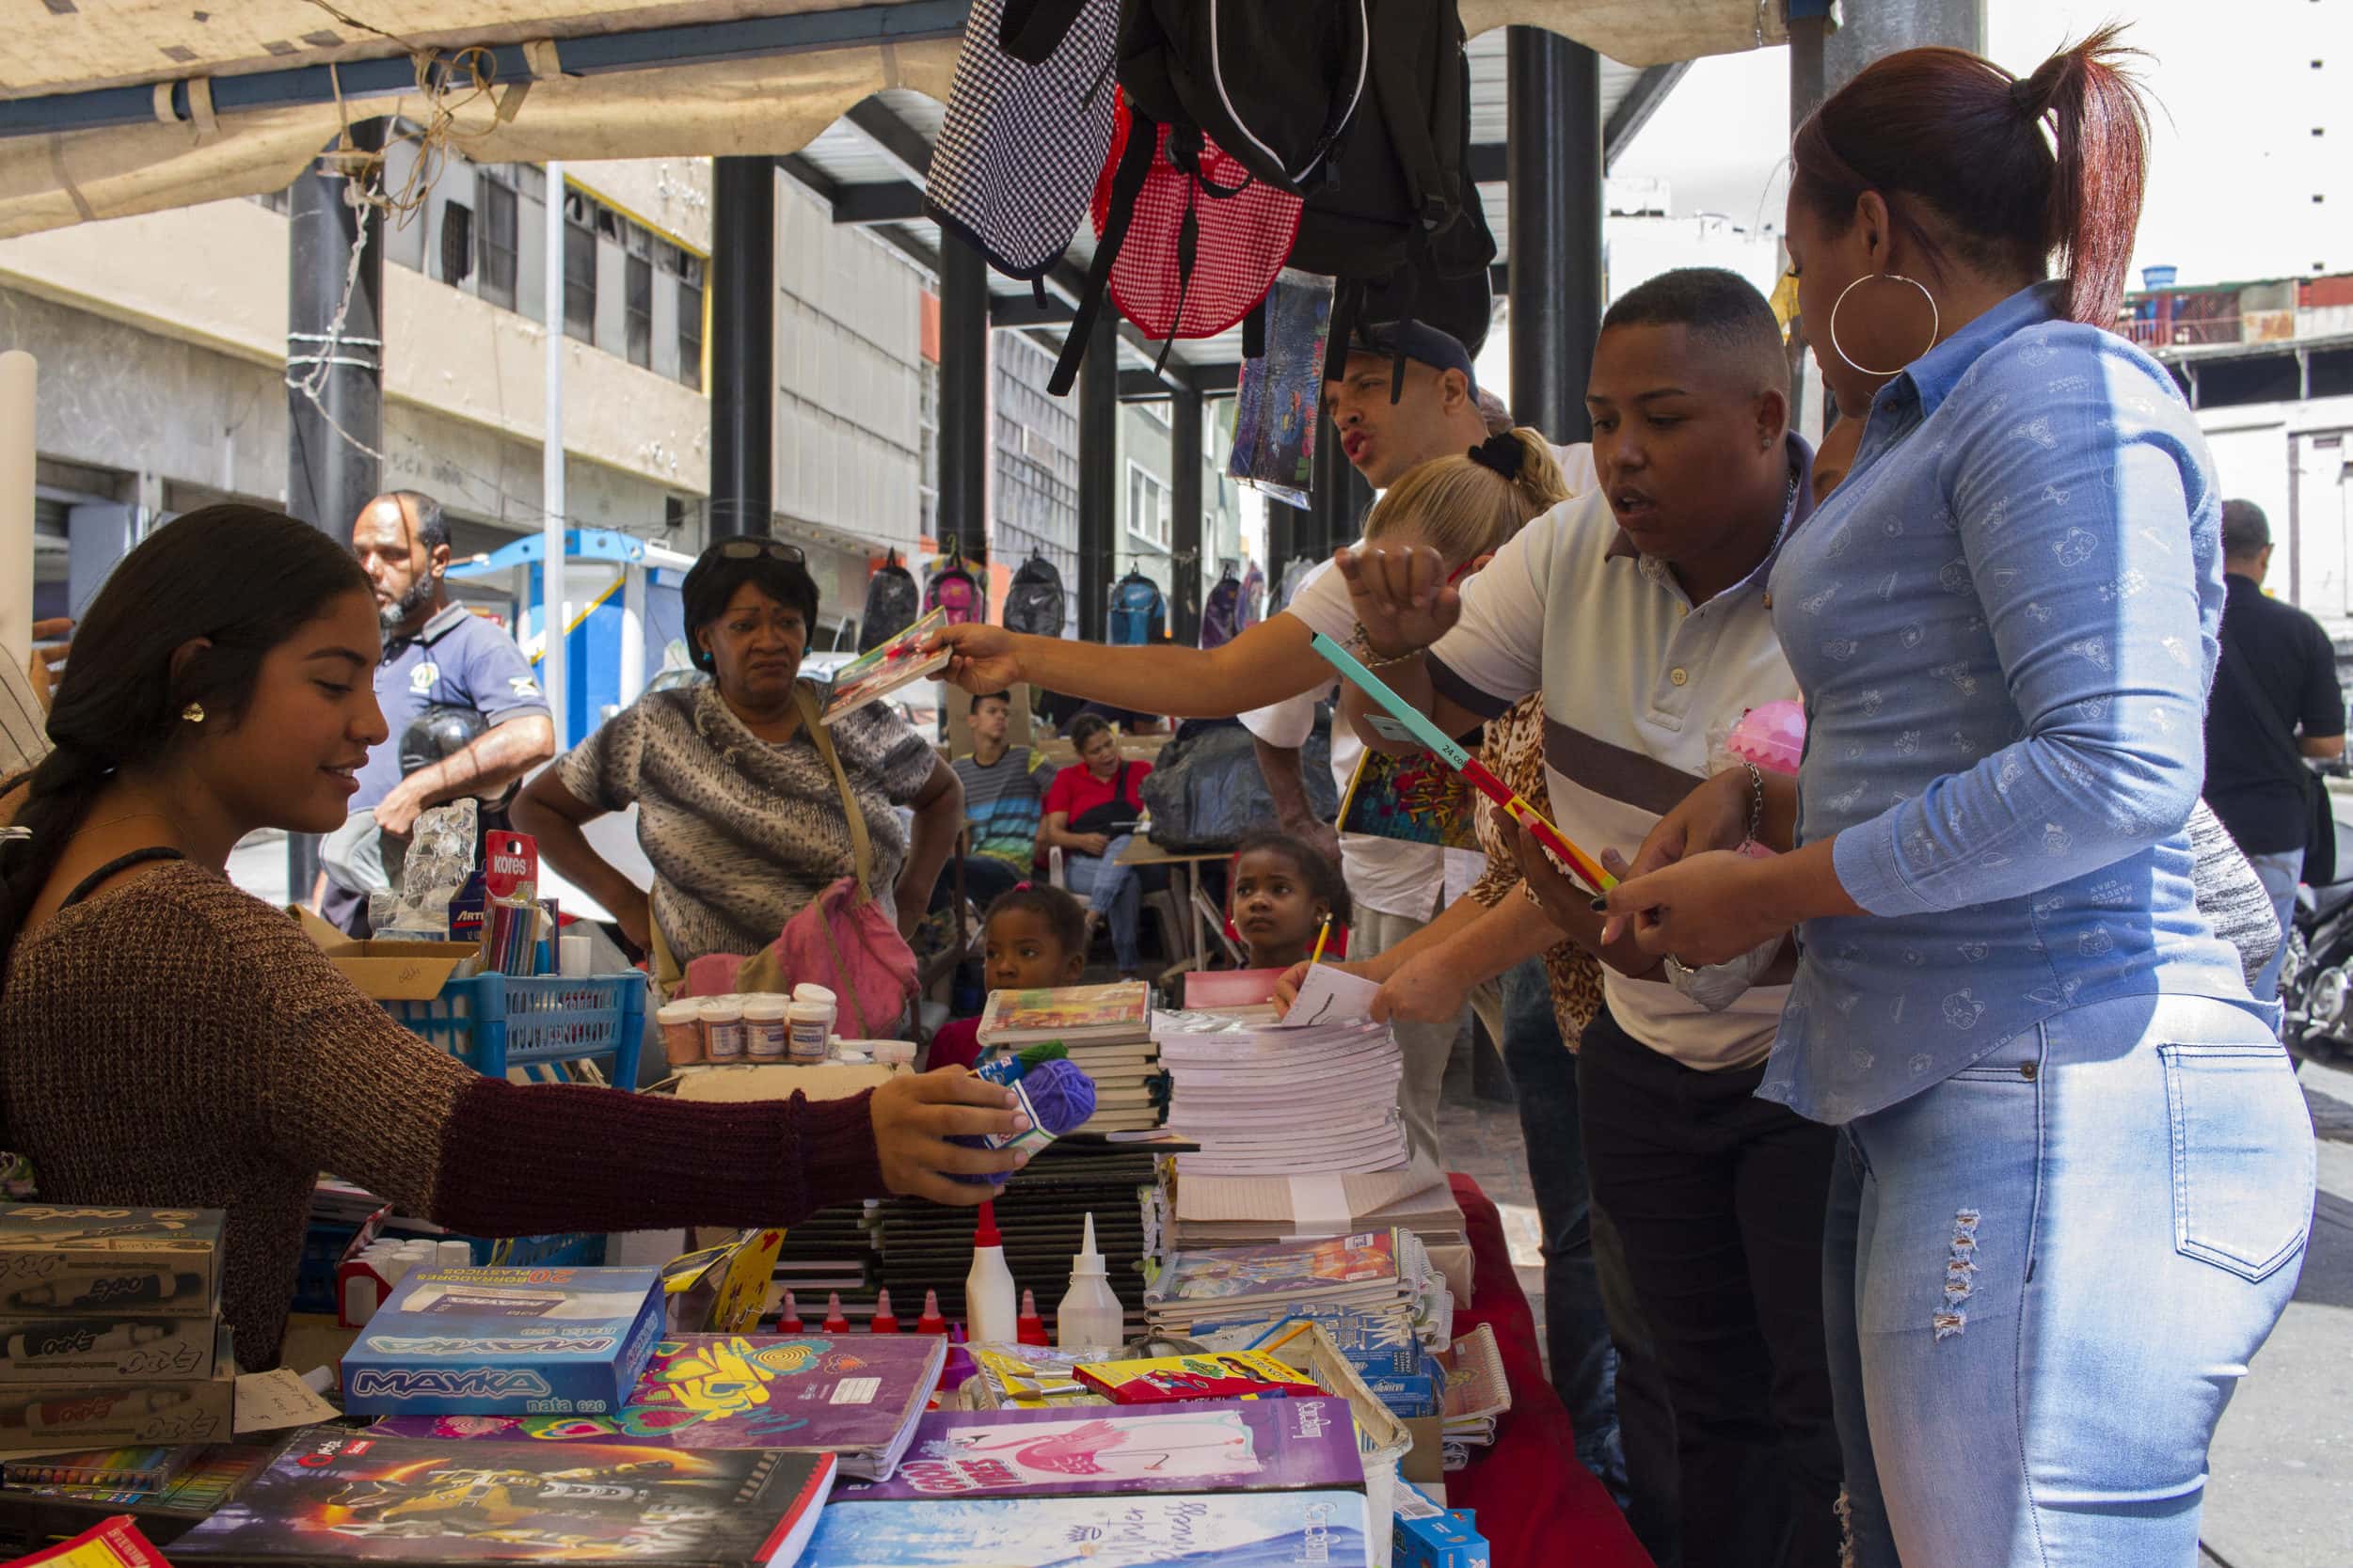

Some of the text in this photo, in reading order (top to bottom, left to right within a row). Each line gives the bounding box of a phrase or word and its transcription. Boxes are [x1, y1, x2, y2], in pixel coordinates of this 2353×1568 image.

[1442, 744, 1455, 756] 24
[527, 1269, 574, 1285] 20
[367, 1336, 616, 1354] MAYKA
[354, 1369, 551, 1398] MAYKA
[527, 1398, 607, 1413] nata 620
